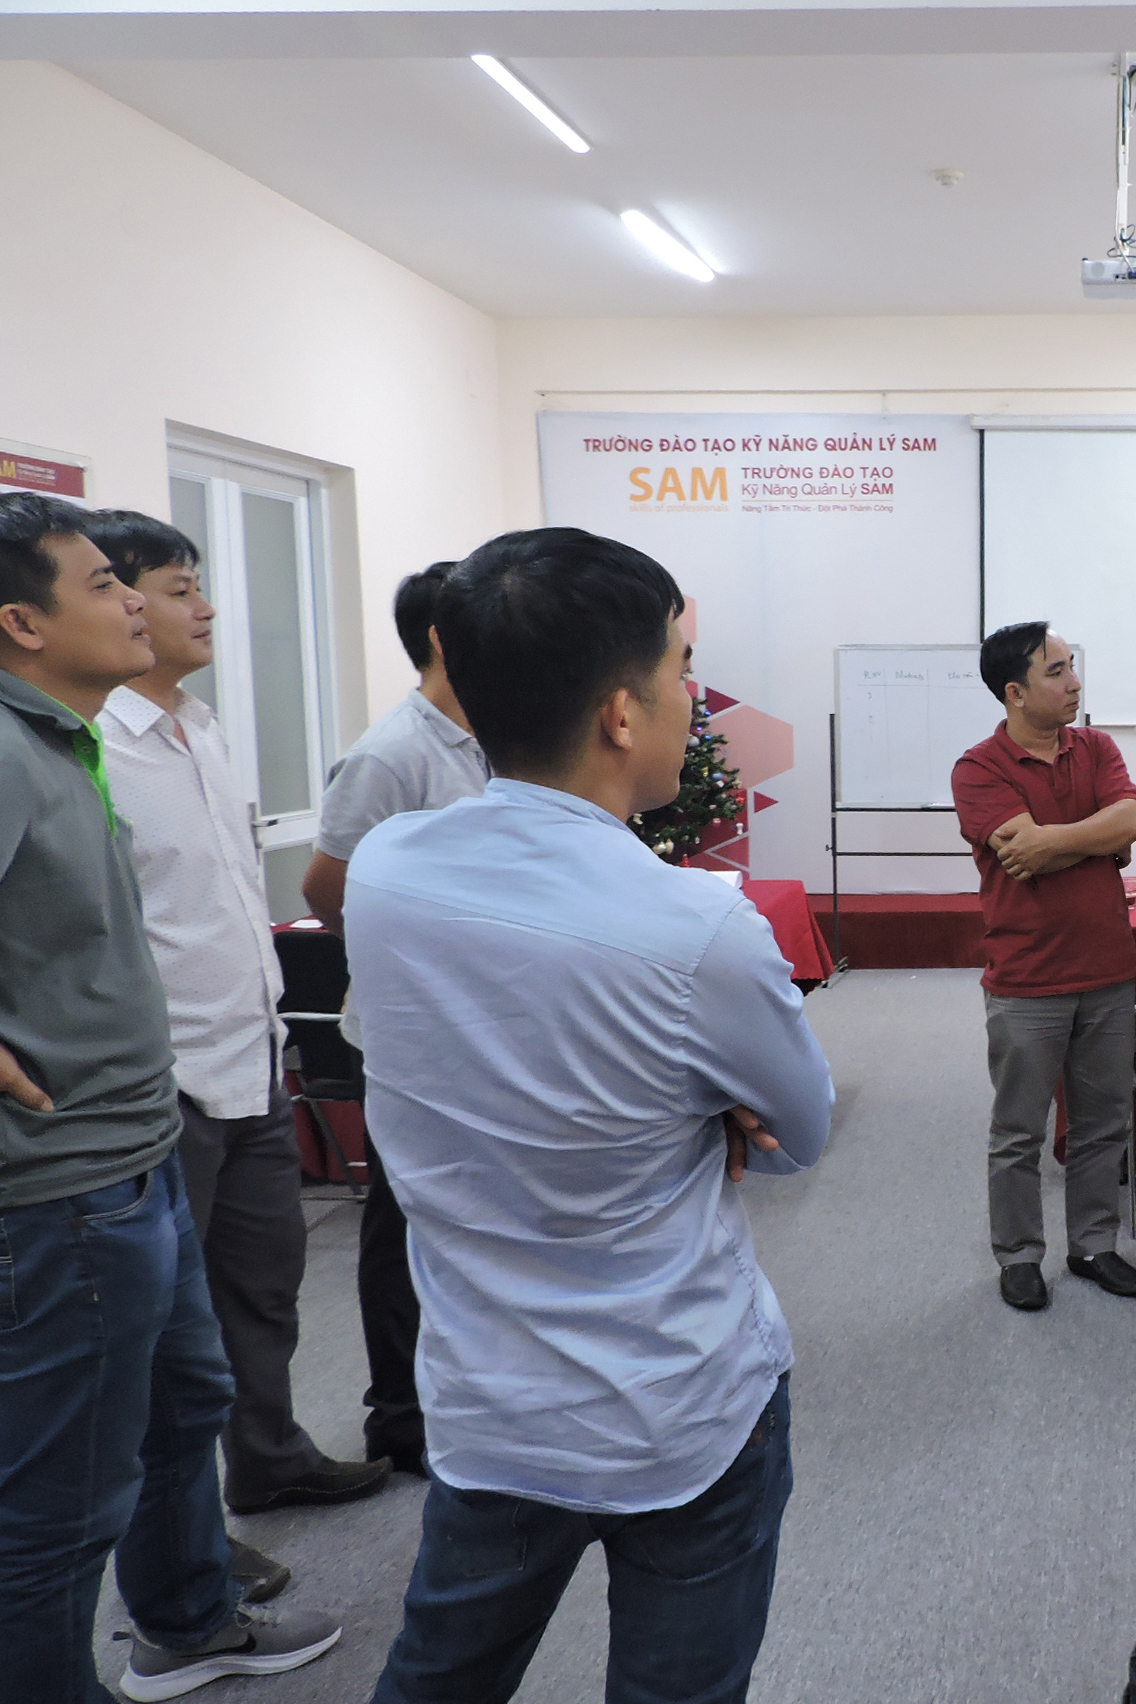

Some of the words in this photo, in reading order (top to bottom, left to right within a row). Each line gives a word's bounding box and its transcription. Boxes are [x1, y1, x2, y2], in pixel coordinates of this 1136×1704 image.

[583, 435, 653, 452] TRƯỜNG
[659, 435, 697, 452] ĐÀO
[702, 438, 736, 456] TẠO
[741, 435, 762, 452] KỸ
[768, 434, 818, 452] NĂNG
[824, 433, 873, 452] QUẢN
[879, 434, 896, 451] LÝ
[901, 437, 937, 452] SAM
[741, 464, 814, 479] TRƯỜNG
[818, 464, 855, 479] ĐÀO
[860, 467, 894, 481] TẠO
[629, 466, 728, 502] SAM
[741, 483, 760, 498] Kỹ
[762, 483, 798, 498] Năng
[801, 482, 838, 496] Quản
[841, 483, 858, 498] Lý
[861, 483, 894, 495] SAM
